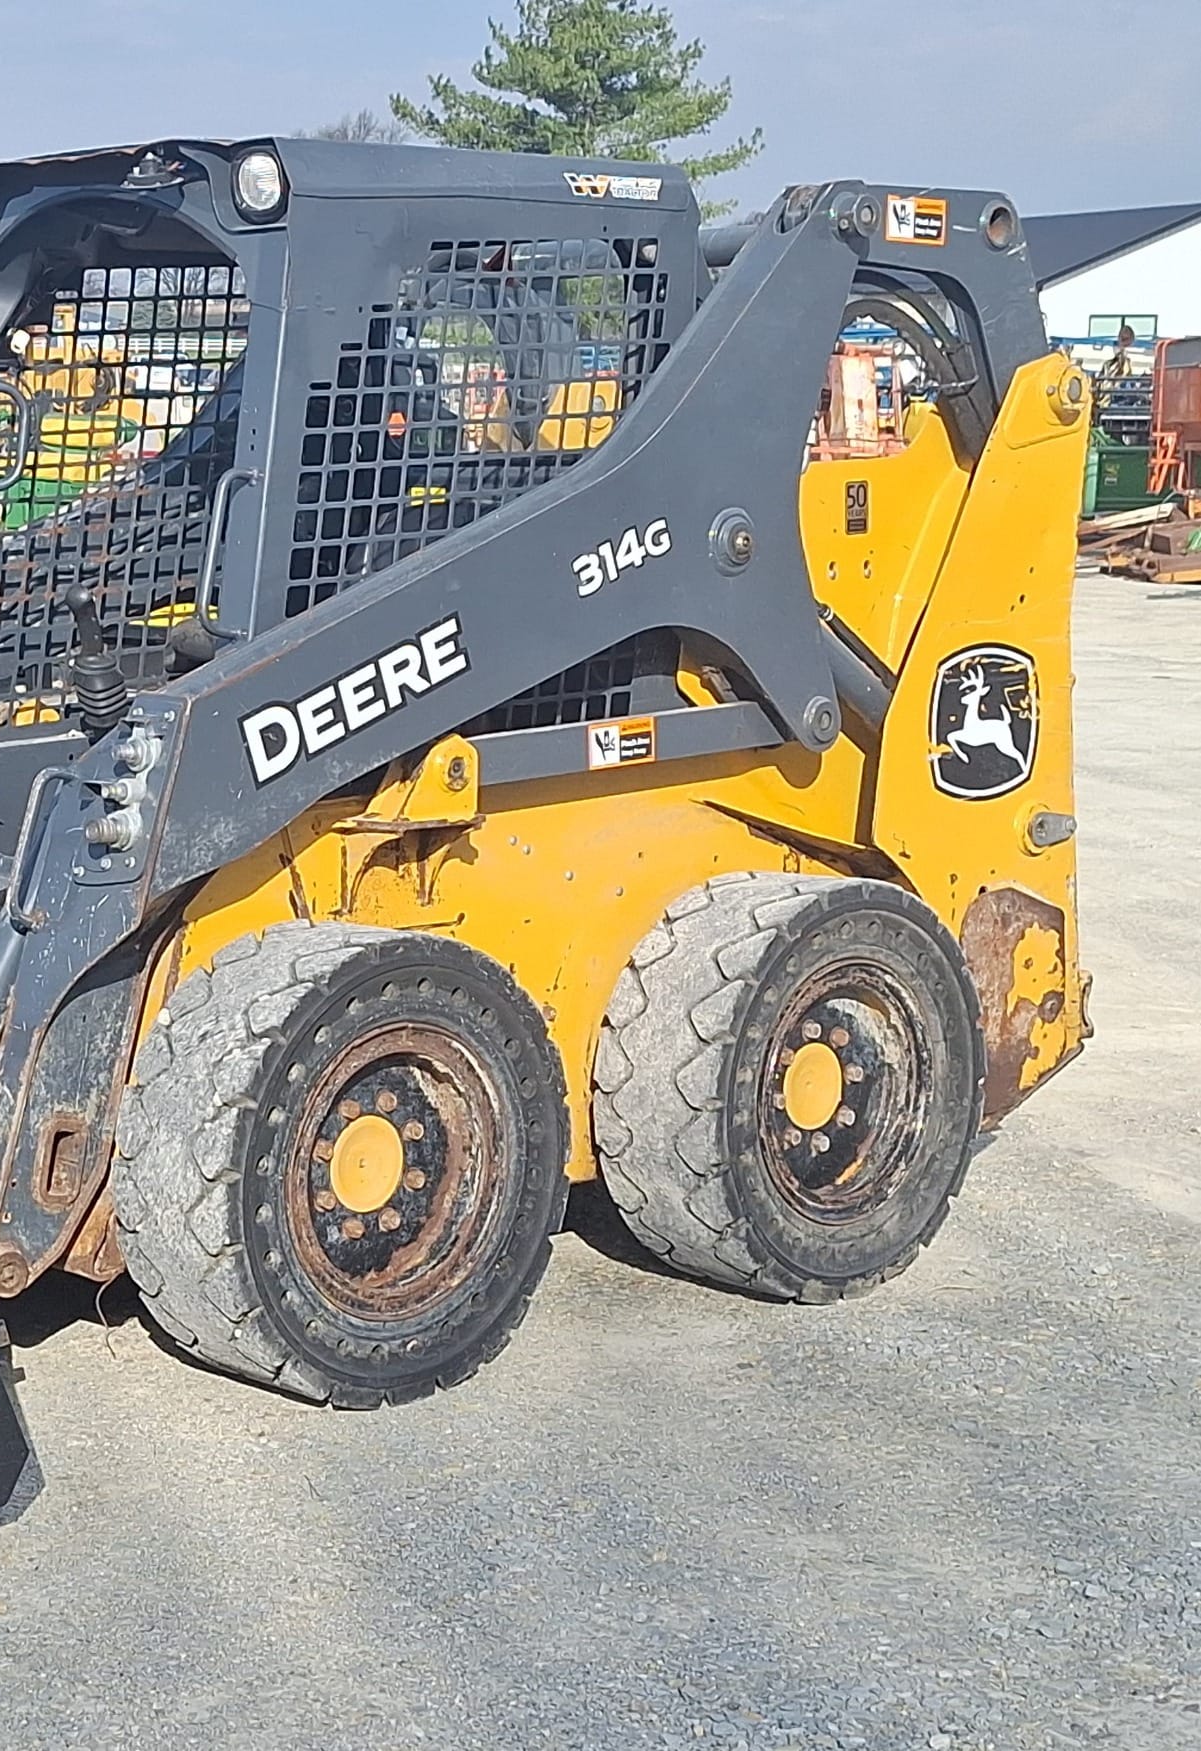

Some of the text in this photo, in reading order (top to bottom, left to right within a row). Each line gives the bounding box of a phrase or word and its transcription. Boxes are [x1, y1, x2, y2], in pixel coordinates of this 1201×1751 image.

[847, 483, 867, 509] 50
[571, 517, 672, 598] 314G
[242, 617, 468, 784] DEERE
